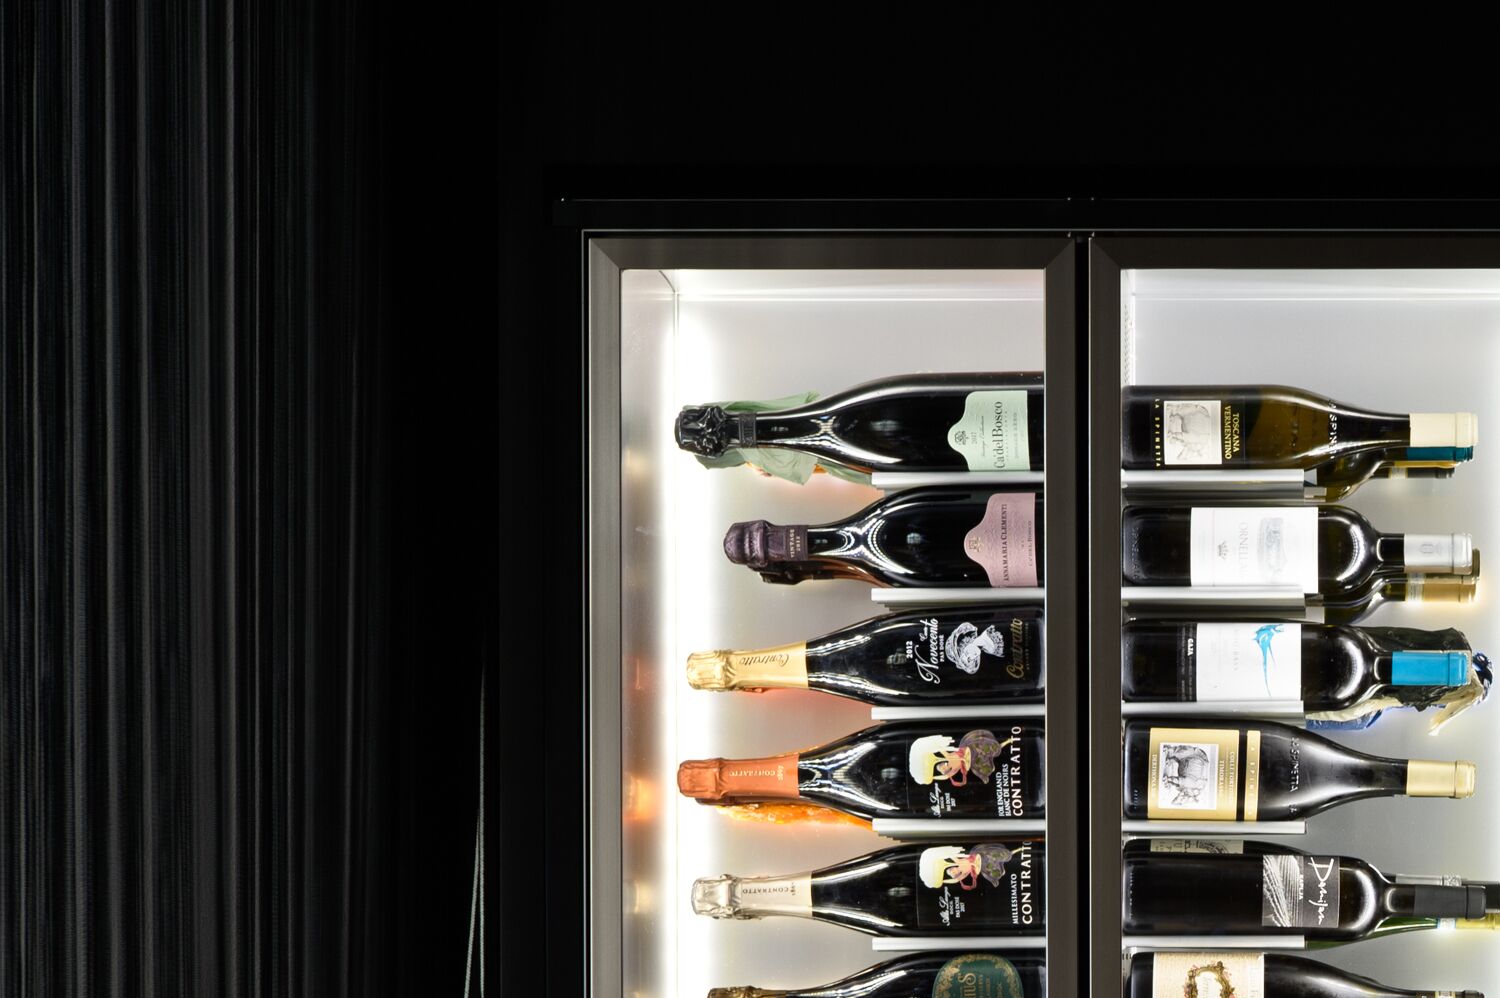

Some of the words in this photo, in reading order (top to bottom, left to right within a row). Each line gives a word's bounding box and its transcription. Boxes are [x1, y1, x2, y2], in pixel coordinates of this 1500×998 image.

[991, 400, 1005, 438] Bosco
[1224, 405, 1232, 460] VERMENTINO
[1232, 412, 1240, 453] TOSCANA
[914, 618, 940, 684] Novecento
[1006, 618, 1024, 678] Contratto
[1186, 638, 1195, 656] GAJA
[995, 772, 1004, 806] ENGLAND
[1001, 763, 1011, 787] NOIRS
[1003, 787, 1011, 797] DE
[1010, 725, 1023, 816] CONTRATTO
[1289, 748, 1300, 793] SPINETTA
[1010, 873, 1019, 924] MILLESIMATO
[1307, 857, 1336, 926] Damijan
